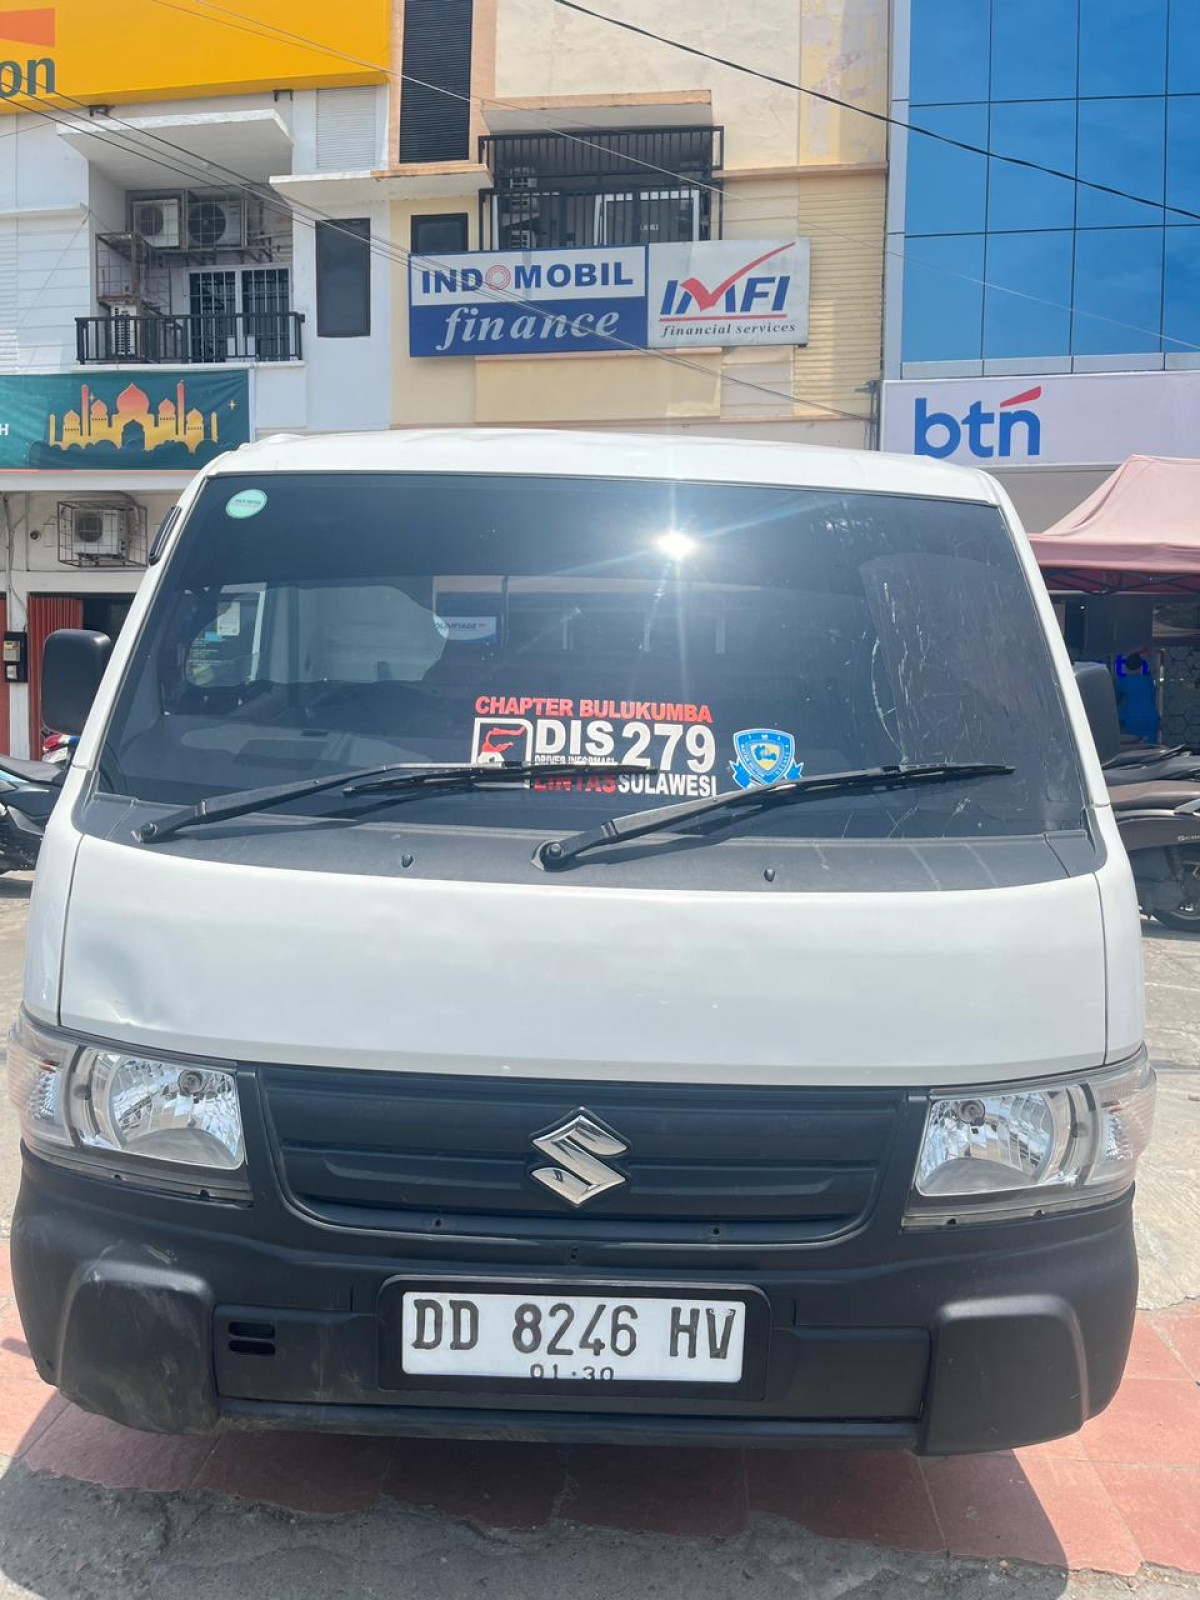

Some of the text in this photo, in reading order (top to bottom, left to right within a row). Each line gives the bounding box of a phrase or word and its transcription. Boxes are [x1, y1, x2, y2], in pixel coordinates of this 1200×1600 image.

[422, 261, 634, 294] INDOMOBIL
[660, 243, 796, 315] IMFI
[435, 306, 620, 352] finance
[660, 322, 796, 338] financial services
[914, 385, 1042, 459] btn
[475, 696, 713, 723] CHAPTER BULUKUMBA
[535, 719, 615, 756] DIS
[621, 721, 716, 774] 279
[617, 773, 717, 797] SULAWESI
[411, 1299, 736, 1359] DD 8246 HV
